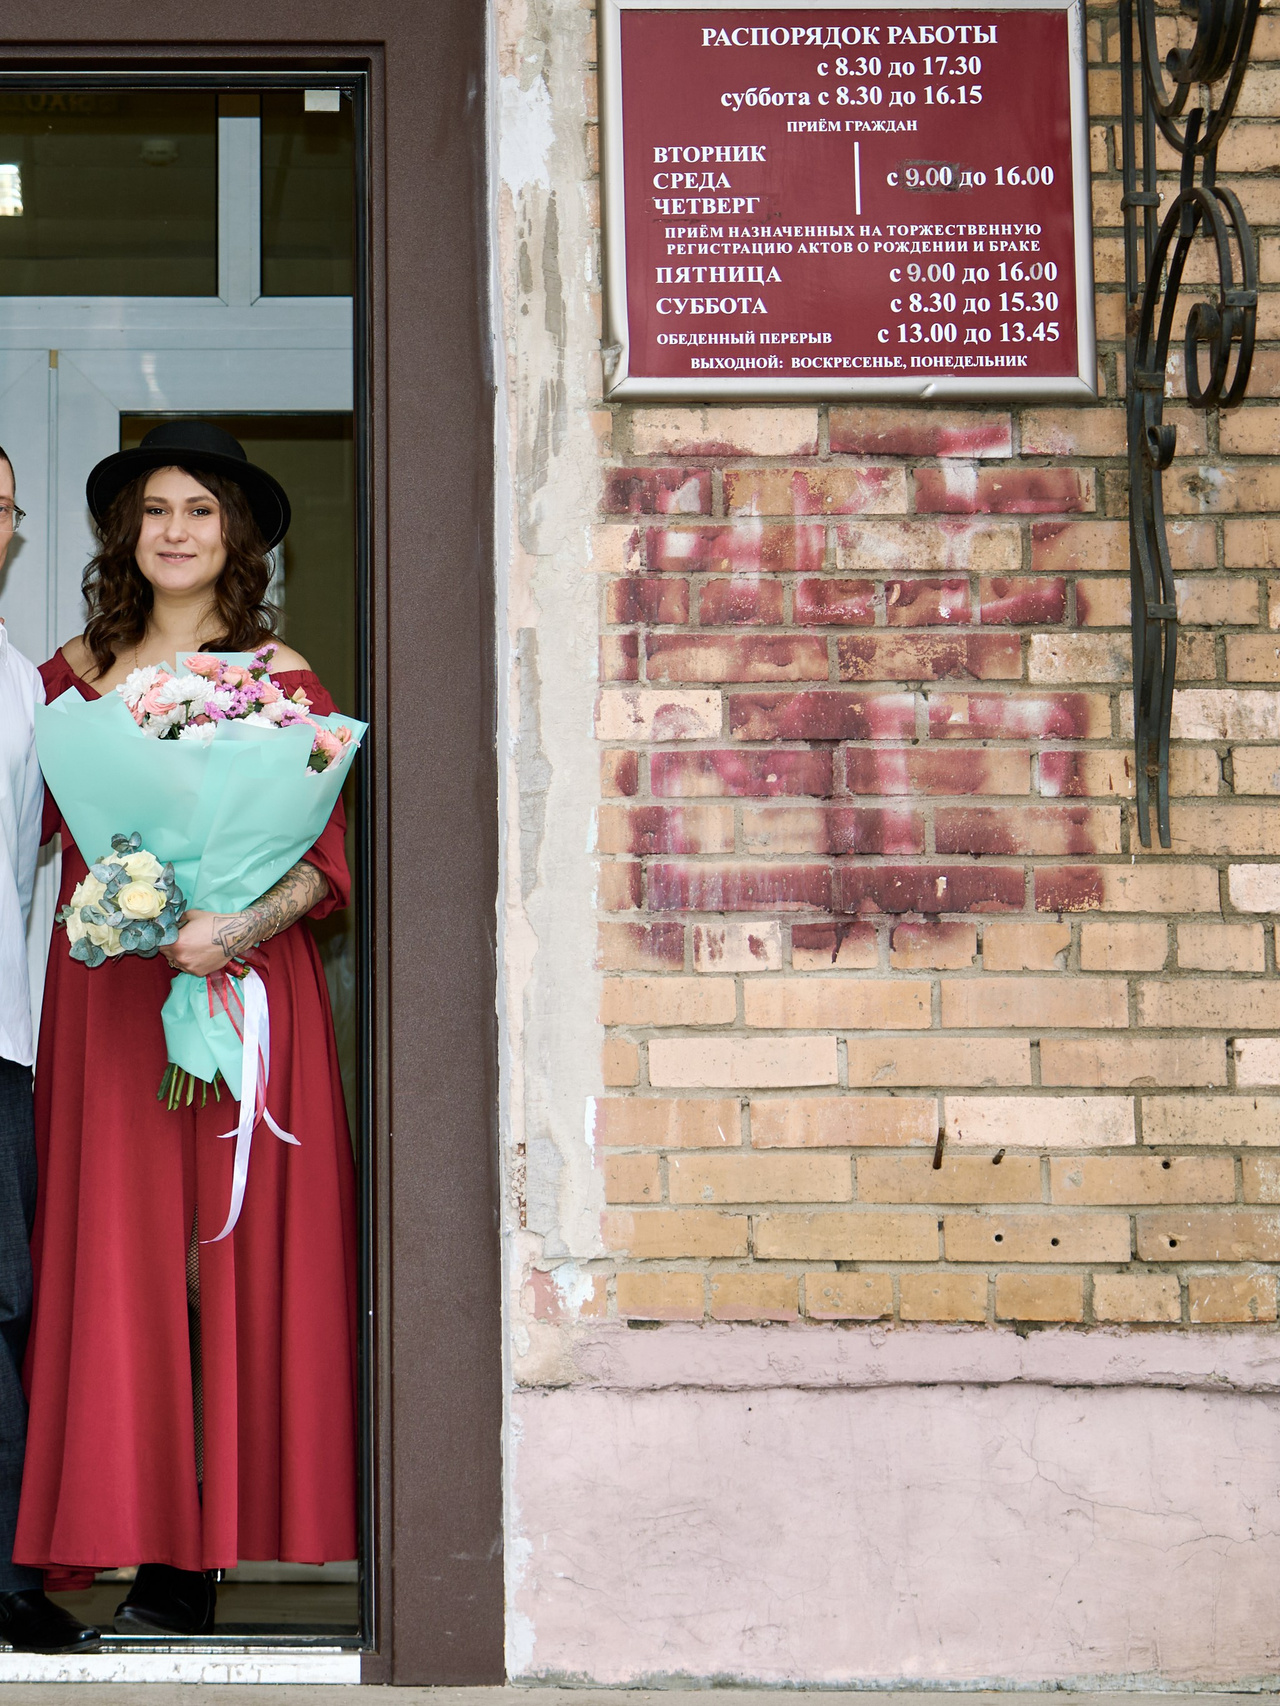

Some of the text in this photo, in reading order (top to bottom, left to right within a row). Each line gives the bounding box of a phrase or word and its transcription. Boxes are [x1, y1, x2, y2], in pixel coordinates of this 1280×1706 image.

[702, 26, 997, 49] РАСПОРЯДОК РАБОТЫ
[817, 56, 981, 78] с 8.30 до 17.30
[721, 86, 982, 111] суббота с 8.30 до 16.15
[787, 119, 917, 133] ПРИЁМ ГРАЖДАН
[654, 146, 766, 163] ВТОРНИК
[653, 173, 731, 192] СРЕДА
[887, 166, 1053, 188] с 9.00 до 16.00
[652, 197, 760, 214] ЧЕТВЕРГ
[665, 224, 1041, 238] ПРИЁМ НАЗНАЧЕННЫХ НА ТОРЖЕСТВЕННУЮ
[667, 241, 1040, 255] РЕГИСТРАЦИЮ АКТОВ О РОЖДЕНИИ И БРАКЕ
[656, 262, 1057, 286] ПЯТНИЦА с 9.00 до 16.00
[656, 292, 1058, 314] СУББОТА с 8.30 до 15.30
[657, 322, 1059, 346] ОБЕДЕННЫЙ ПЕРЕРЫВ с 13.00 до 13.45
[691, 355, 1027, 370] ВЫХОДНОЙ: ВОСКРЕСЕНЬЕ, ПОНЕДЕЛЬНИК
